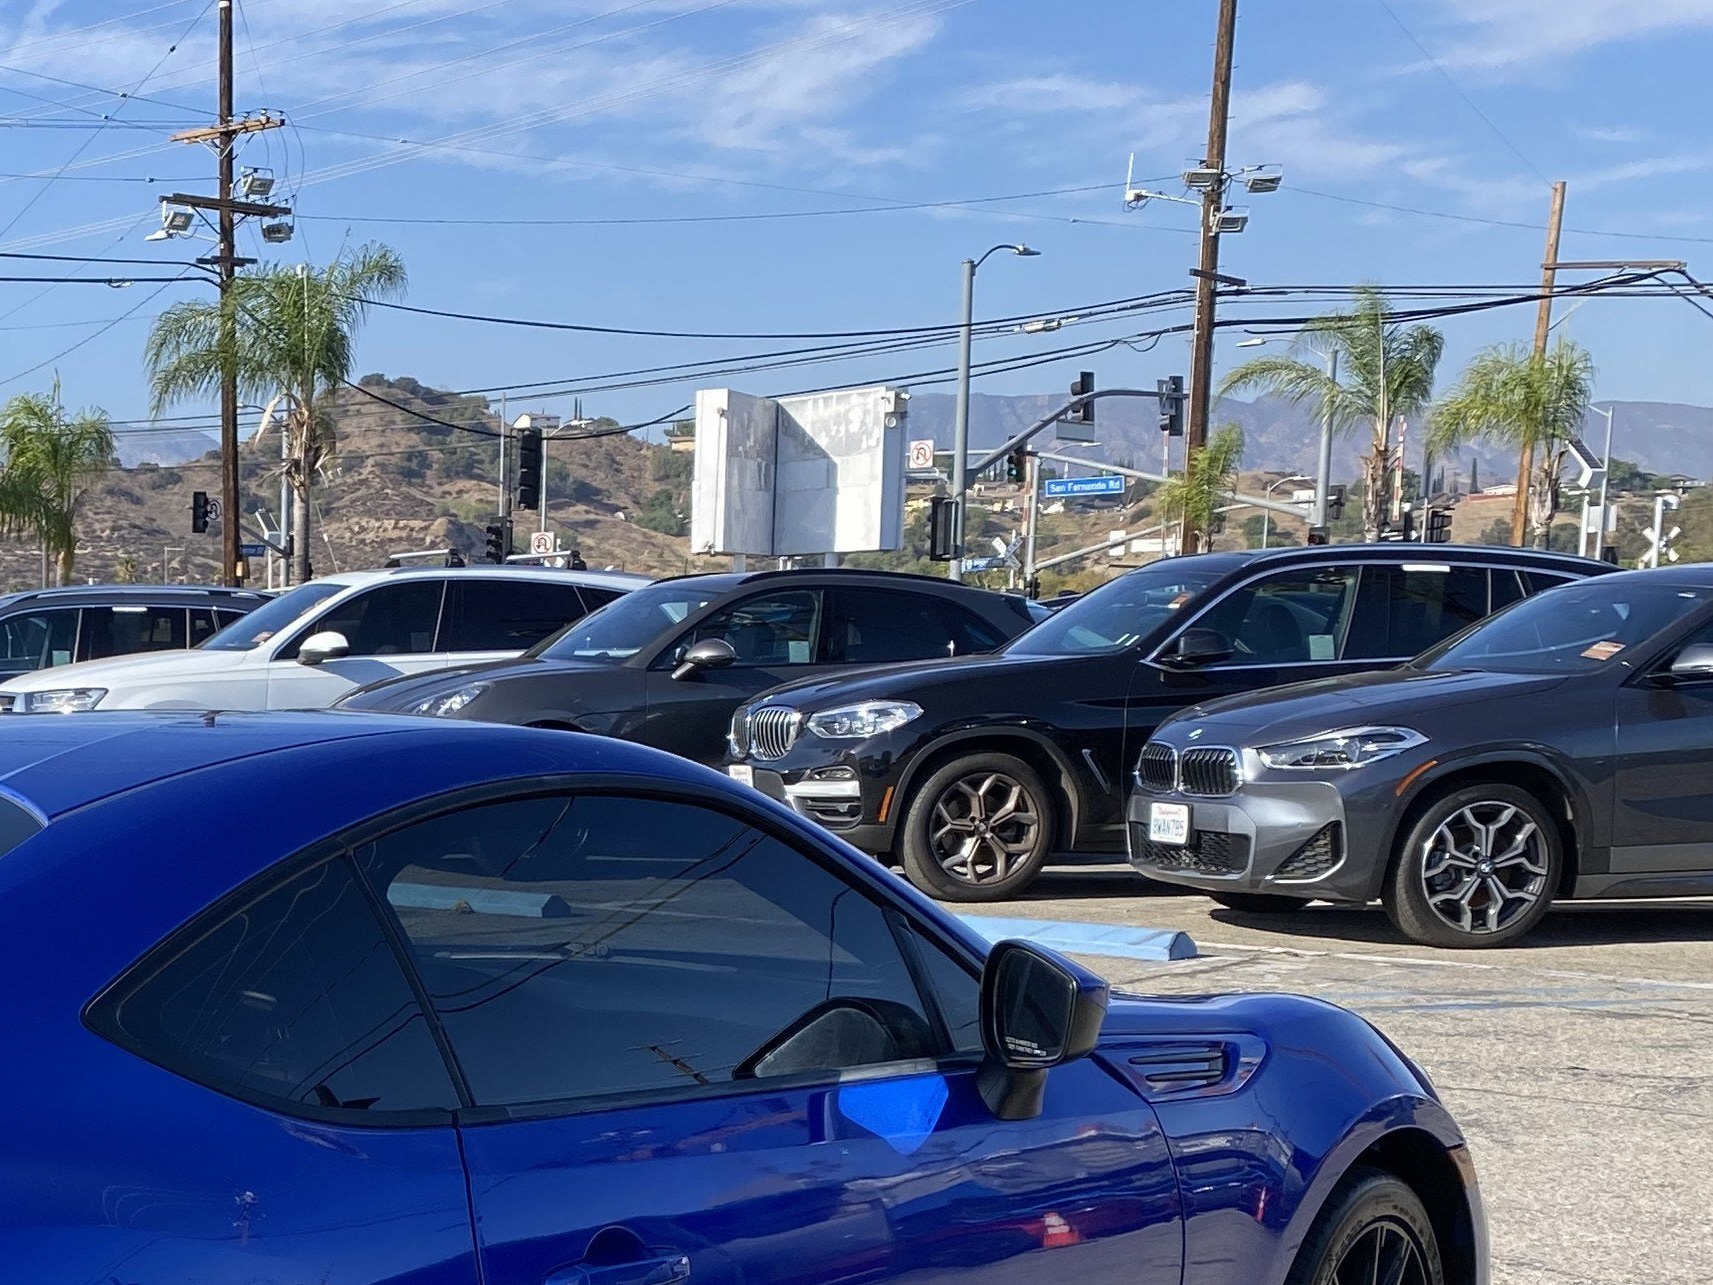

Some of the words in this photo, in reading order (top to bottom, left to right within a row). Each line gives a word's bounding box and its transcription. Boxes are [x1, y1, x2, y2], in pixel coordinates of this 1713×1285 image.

[1050, 482, 1066, 493] San
[1068, 481, 1106, 492] Fernando
[1109, 480, 1120, 489] Rd
